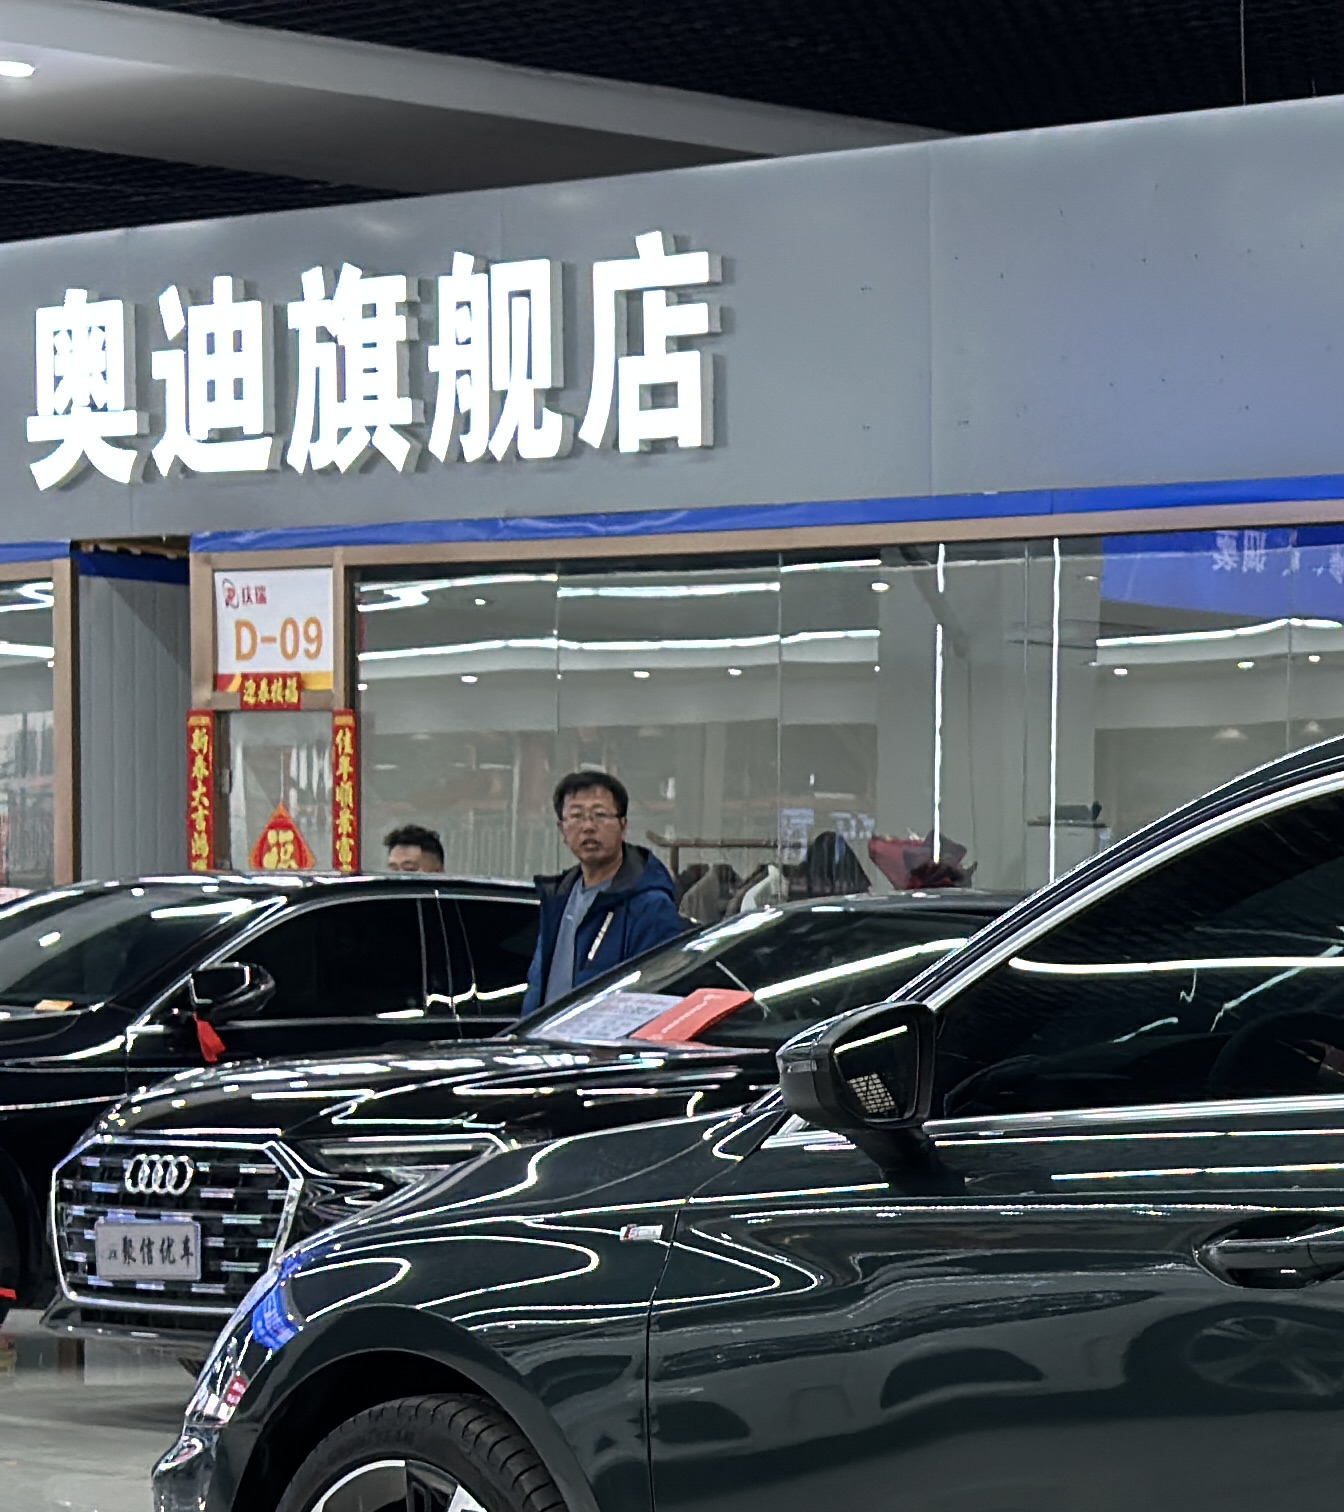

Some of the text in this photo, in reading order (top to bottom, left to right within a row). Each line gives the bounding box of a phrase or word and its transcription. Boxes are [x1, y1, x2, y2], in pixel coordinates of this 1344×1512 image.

[26, 229, 715, 491] 奥迪旗舰店
[234, 616, 324, 662] D-09
